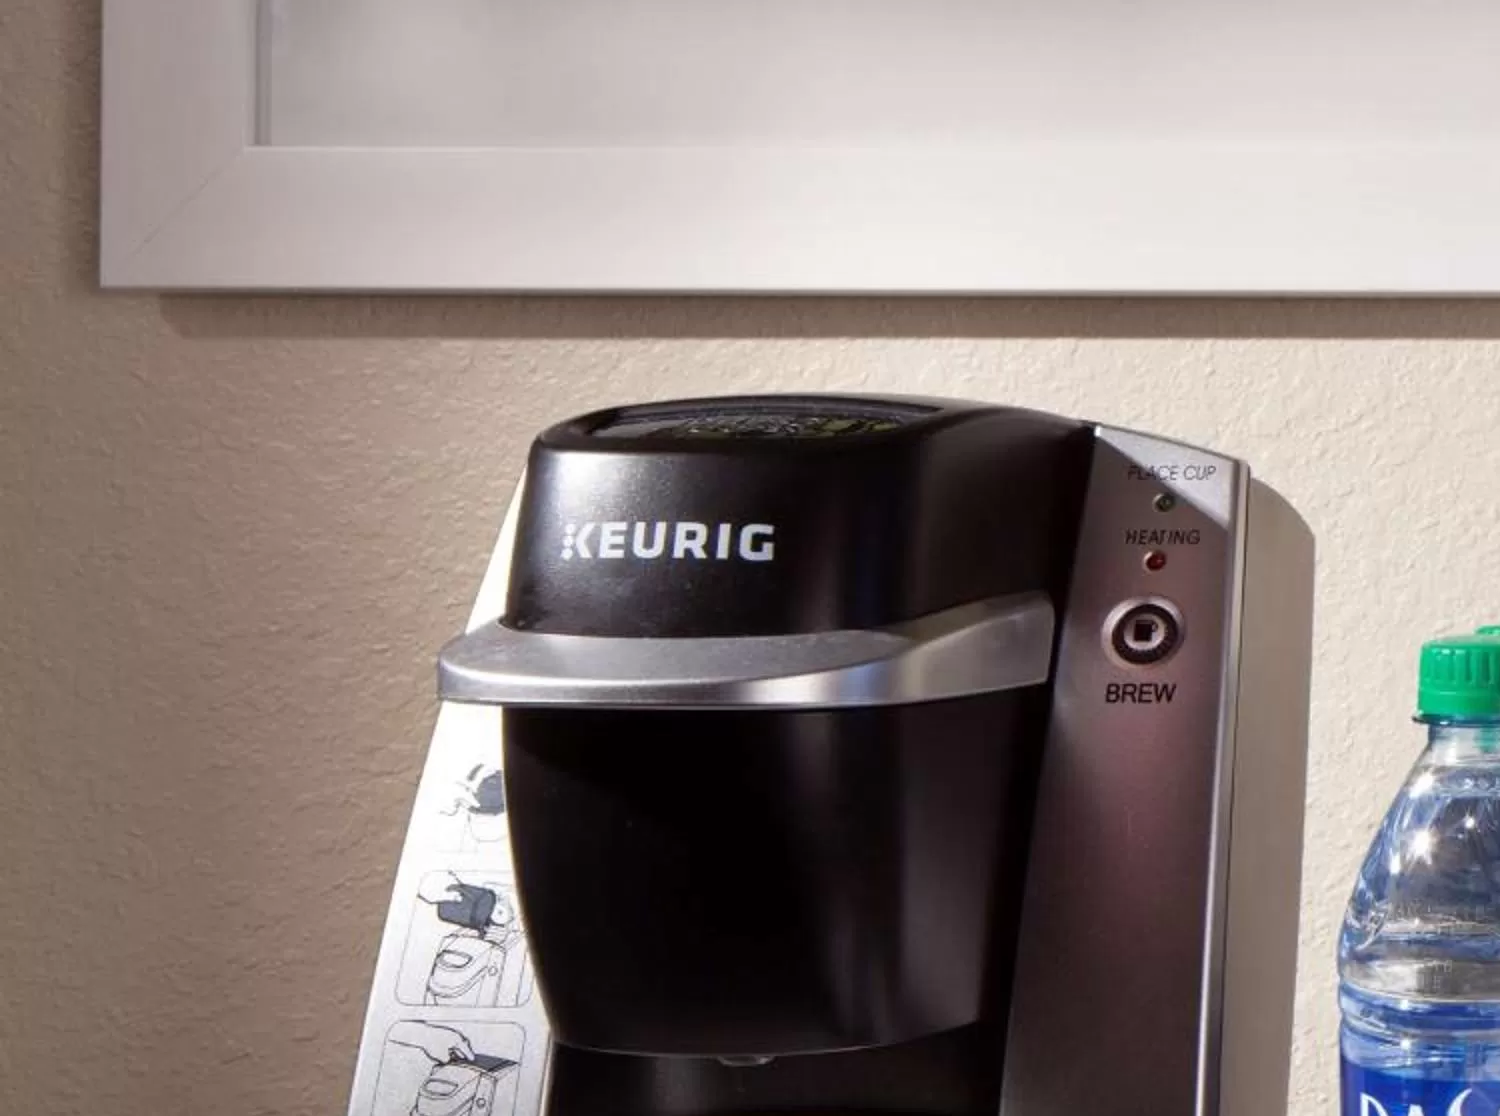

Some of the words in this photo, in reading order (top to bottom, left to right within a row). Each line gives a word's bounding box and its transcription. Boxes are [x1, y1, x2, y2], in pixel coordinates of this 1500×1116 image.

[1127, 465, 1179, 481] PLACE
[1183, 465, 1217, 481] CUP
[562, 521, 775, 562] KEURIG
[1125, 528, 1201, 545] HEATING
[1105, 683, 1177, 704] BREW
